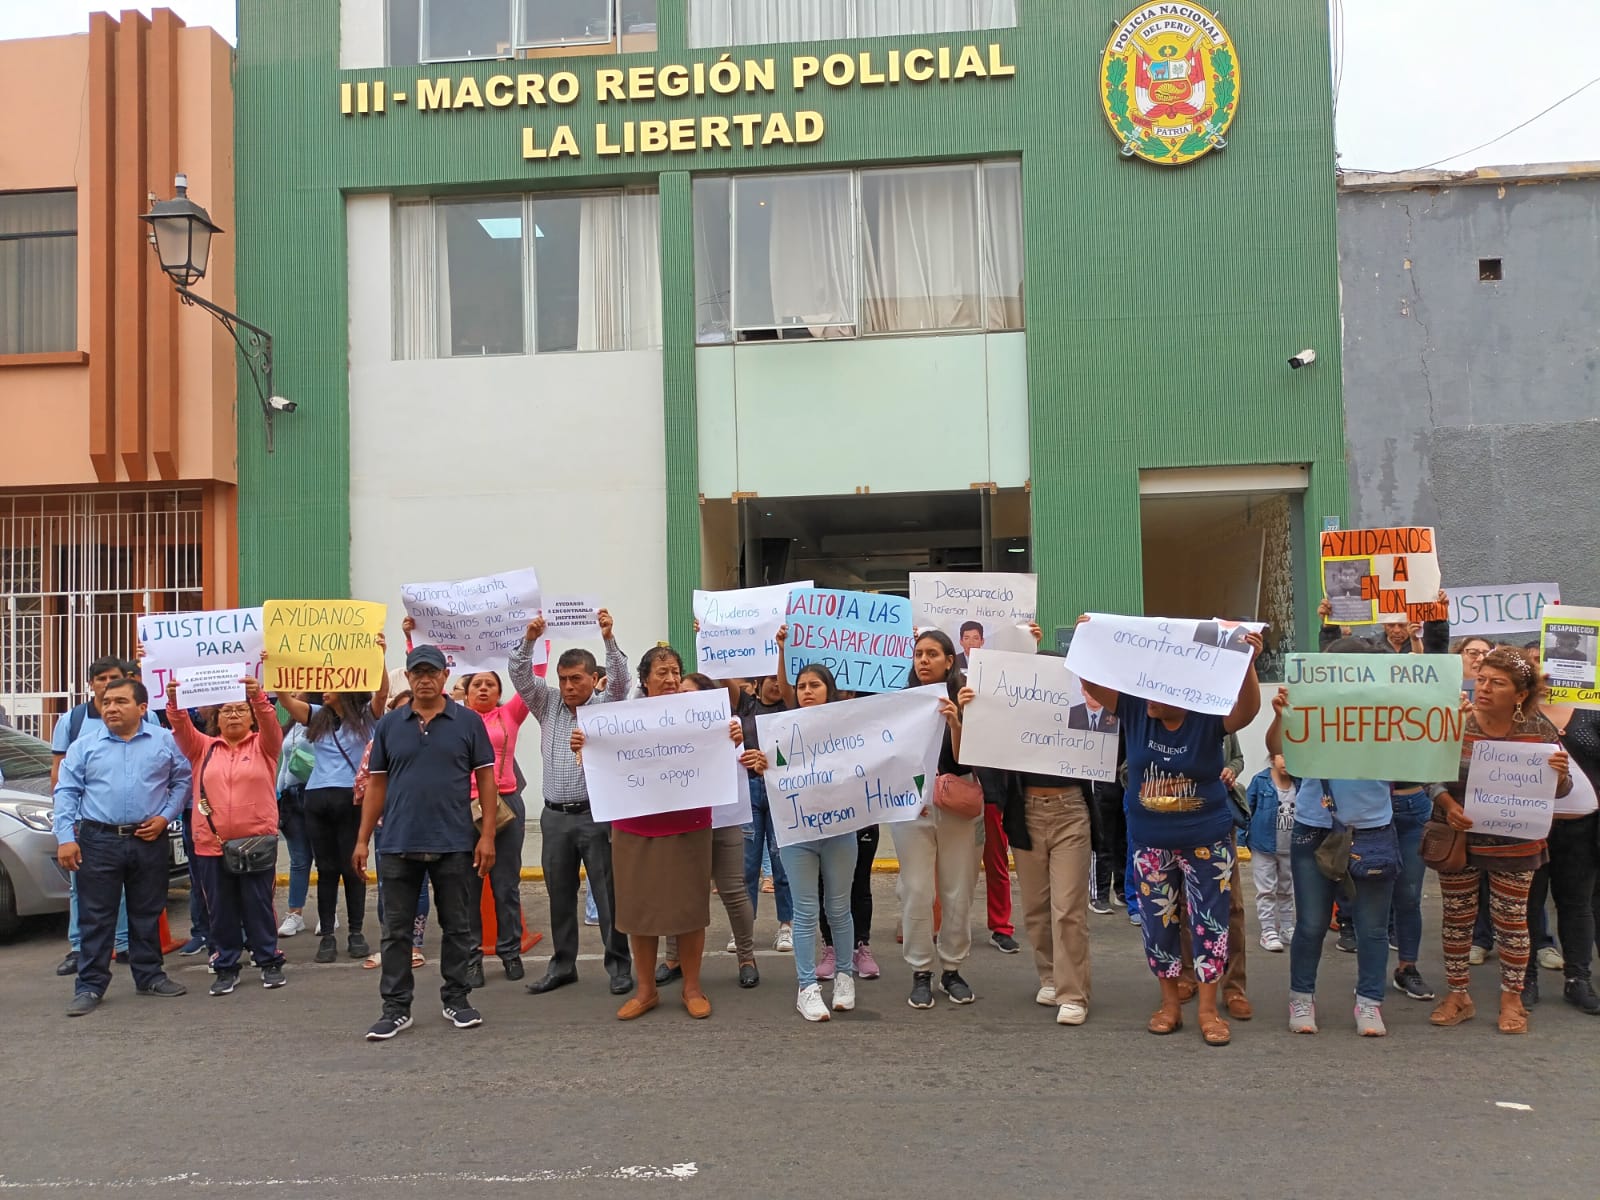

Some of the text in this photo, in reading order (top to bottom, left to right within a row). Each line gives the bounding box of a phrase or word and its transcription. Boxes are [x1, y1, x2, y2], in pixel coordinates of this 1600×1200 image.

[1142, 23, 1162, 38] DEL
[1159, 5, 1220, 42] NACIONAL
[340, 82, 385, 114] III
[416, 71, 580, 110] MACRO
[595, 53, 777, 100] REGIÓN
[792, 43, 1017, 89] POLICIAL
[522, 110, 825, 159] LA LIBERTAD
[1155, 126, 1190, 136] PATRIA
[1322, 528, 1432, 556] AYUDANOS
[1393, 556, 1408, 581] A
[935, 580, 1013, 602] Desaparecido
[270, 603, 366, 628] AYÚDANOS
[509, 610, 526, 619] nos
[771, 607, 778, 616] a
[846, 598, 859, 620] A
[868, 601, 901, 624] LAS
[976, 605, 1005, 618] Hilario
[1158, 622, 1169, 634] a
[1549, 624, 1594, 634] DESAPARECIDO
[196, 640, 245, 657] PARA
[279, 633, 291, 653] A
[790, 623, 914, 660] DESAPARICIONES
[322, 652, 333, 666] A
[273, 666, 368, 690] JHEFERSON
[822, 656, 907, 689] PATAZ
[1390, 664, 1439, 685] PARA
[658, 709, 677, 728] de
[1053, 712, 1063, 723] a
[1285, 705, 1463, 744] JHEFERSON
[882, 728, 894, 743] a
[616, 742, 695, 762] necesitamos
[1526, 752, 1544, 766] de
[778, 764, 865, 792] encontrar a
[1058, 761, 1075, 775] Por
[1473, 787, 1548, 810] Necesitamos
